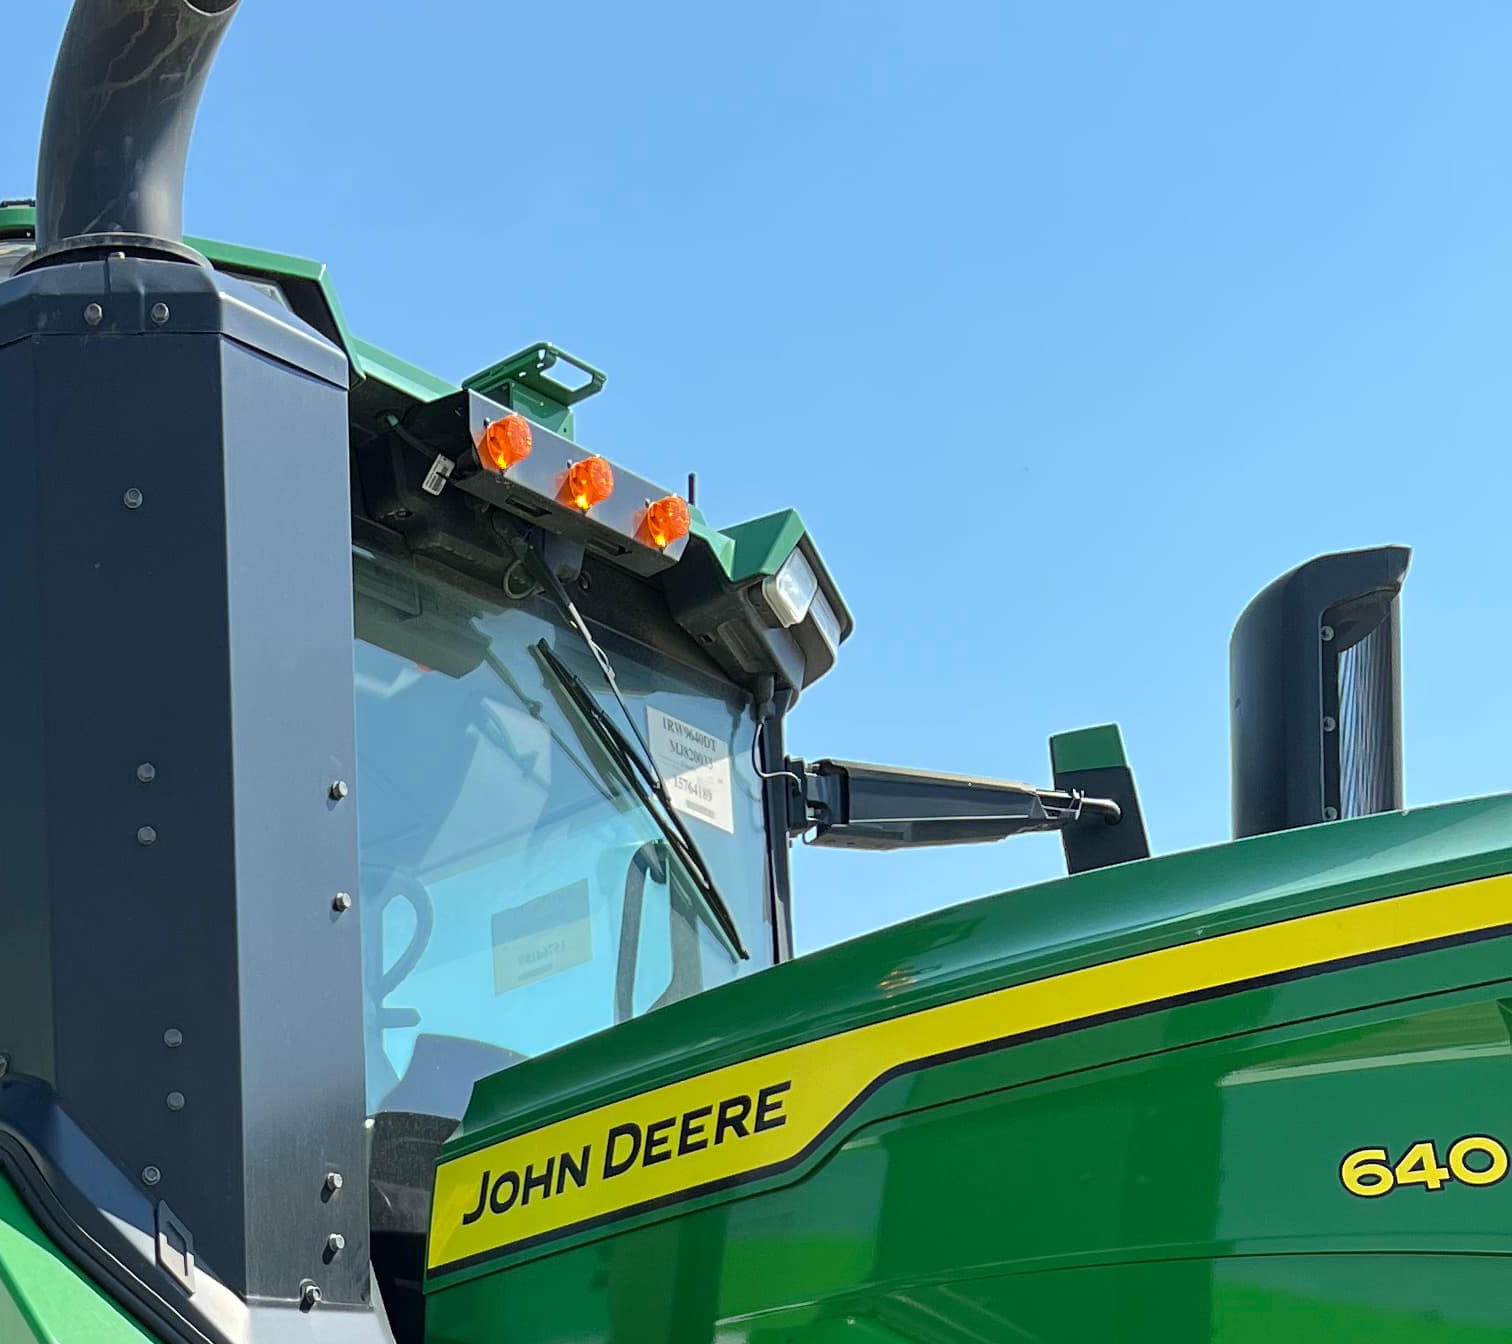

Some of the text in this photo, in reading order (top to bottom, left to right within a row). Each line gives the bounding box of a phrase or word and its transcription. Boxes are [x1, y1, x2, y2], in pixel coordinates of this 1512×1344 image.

[461, 1080, 792, 1225] JOHN DEERE
[1340, 1134, 1510, 1198] 640
